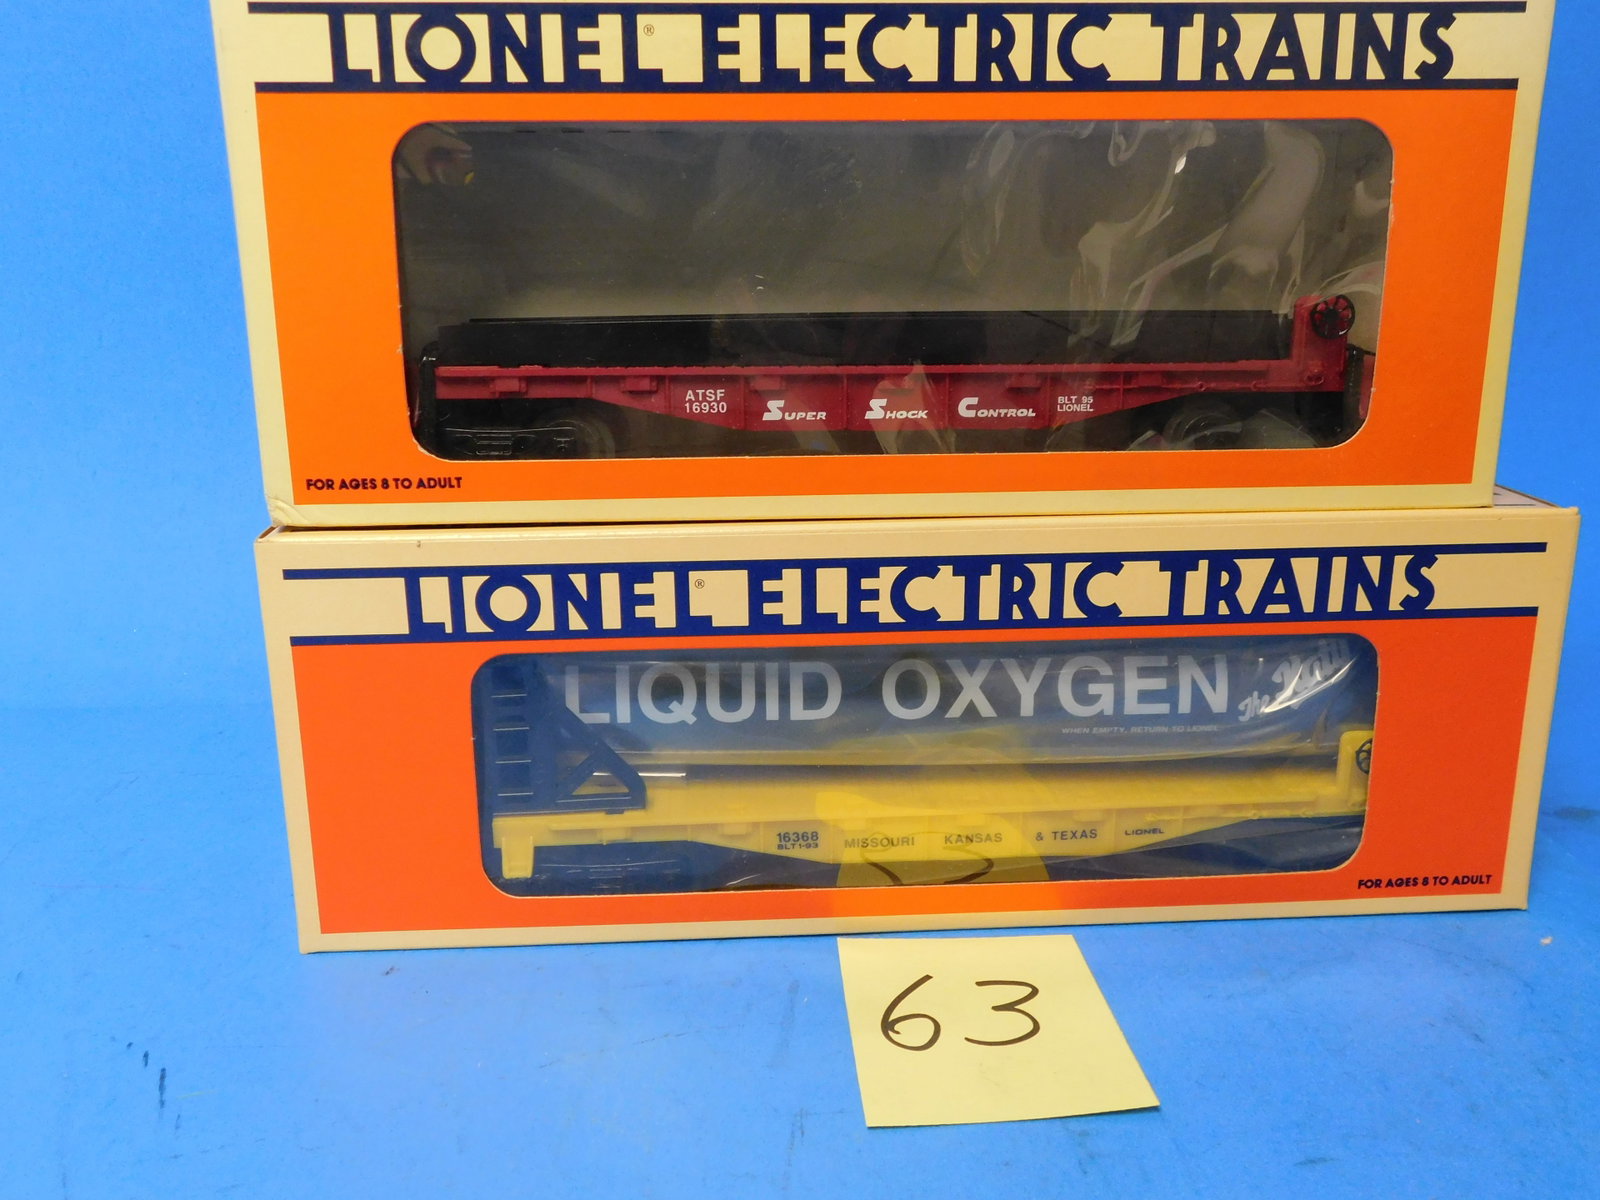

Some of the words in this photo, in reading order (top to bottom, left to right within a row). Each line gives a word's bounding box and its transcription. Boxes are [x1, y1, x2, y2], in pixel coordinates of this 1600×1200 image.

[329, 11, 665, 85] LIONEL
[702, 11, 1113, 84] ELECTRIC
[1149, 10, 1457, 82] TRAINS
[685, 389, 725, 401] ATSF
[1057, 396, 1077, 404] BLT
[1081, 396, 1094, 404] 95
[684, 402, 727, 413] 16930
[1057, 404, 1094, 412] LIONEL
[305, 479, 335, 490] FOR
[338, 478, 377, 490] AGES
[381, 478, 390, 489] 8
[393, 478, 412, 489] TO
[416, 477, 462, 489] ADULT
[404, 570, 713, 634] LIONEL
[748, 560, 1125, 627] ELECTRIC
[1159, 554, 1439, 617] TRAINS
[564, 661, 843, 725] LIQUID
[881, 654, 1229, 721] OXYGEN
[1061, 727, 1090, 735] WHEN
[1130, 726, 1168, 734] RETURN
[1172, 725, 1185, 733] TO
[776, 831, 819, 843] 16368
[1125, 827, 1165, 836] LIONEL
[844, 837, 915, 848] MISSOURI
[944, 833, 1003, 845] KANSAS
[1035, 832, 1044, 841] &
[1052, 829, 1098, 841] TEXAS
[1357, 879, 1382, 889] FOR
[1385, 877, 1419, 888] AGES
[1422, 877, 1430, 886] 8
[1433, 876, 1449, 886] TO
[1452, 874, 1492, 885] ADULT
[880, 973, 1041, 1052] 63
